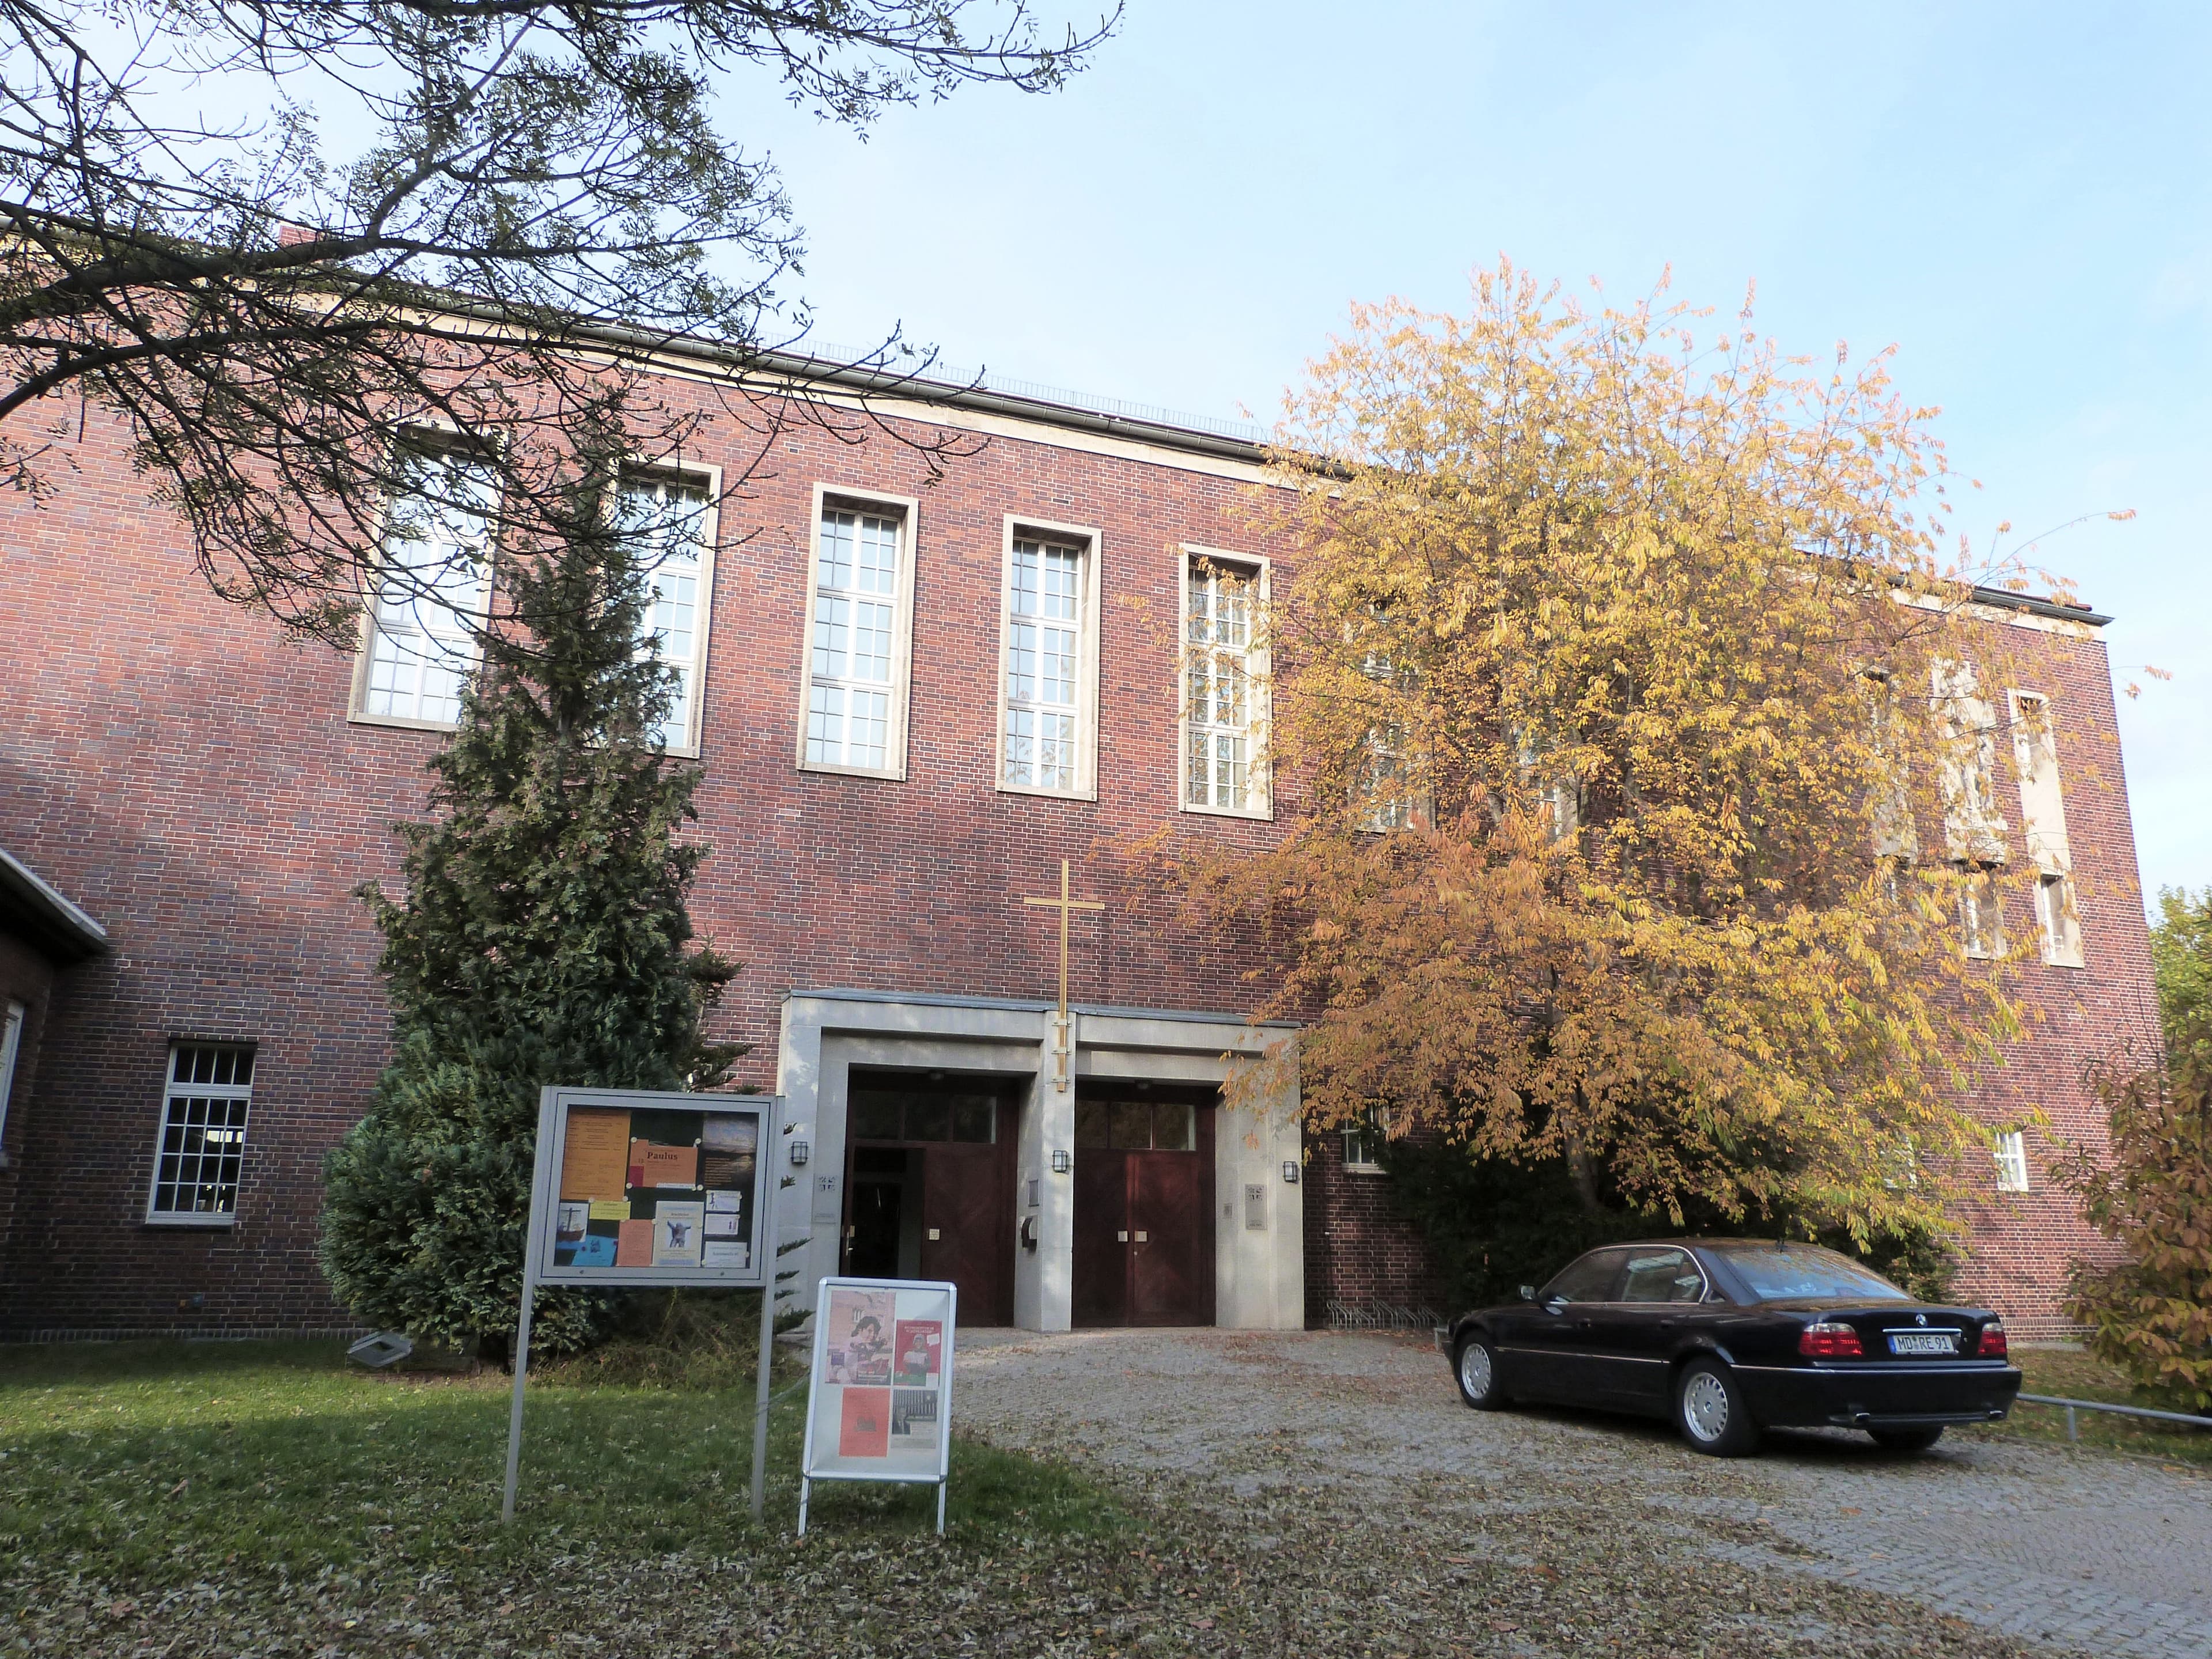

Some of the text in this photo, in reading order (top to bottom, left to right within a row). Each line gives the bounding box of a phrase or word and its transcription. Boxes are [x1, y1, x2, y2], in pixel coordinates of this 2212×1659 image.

[647, 1152, 678, 1160] Paulus
[1897, 1336, 1949, 1350] MD RE 91
